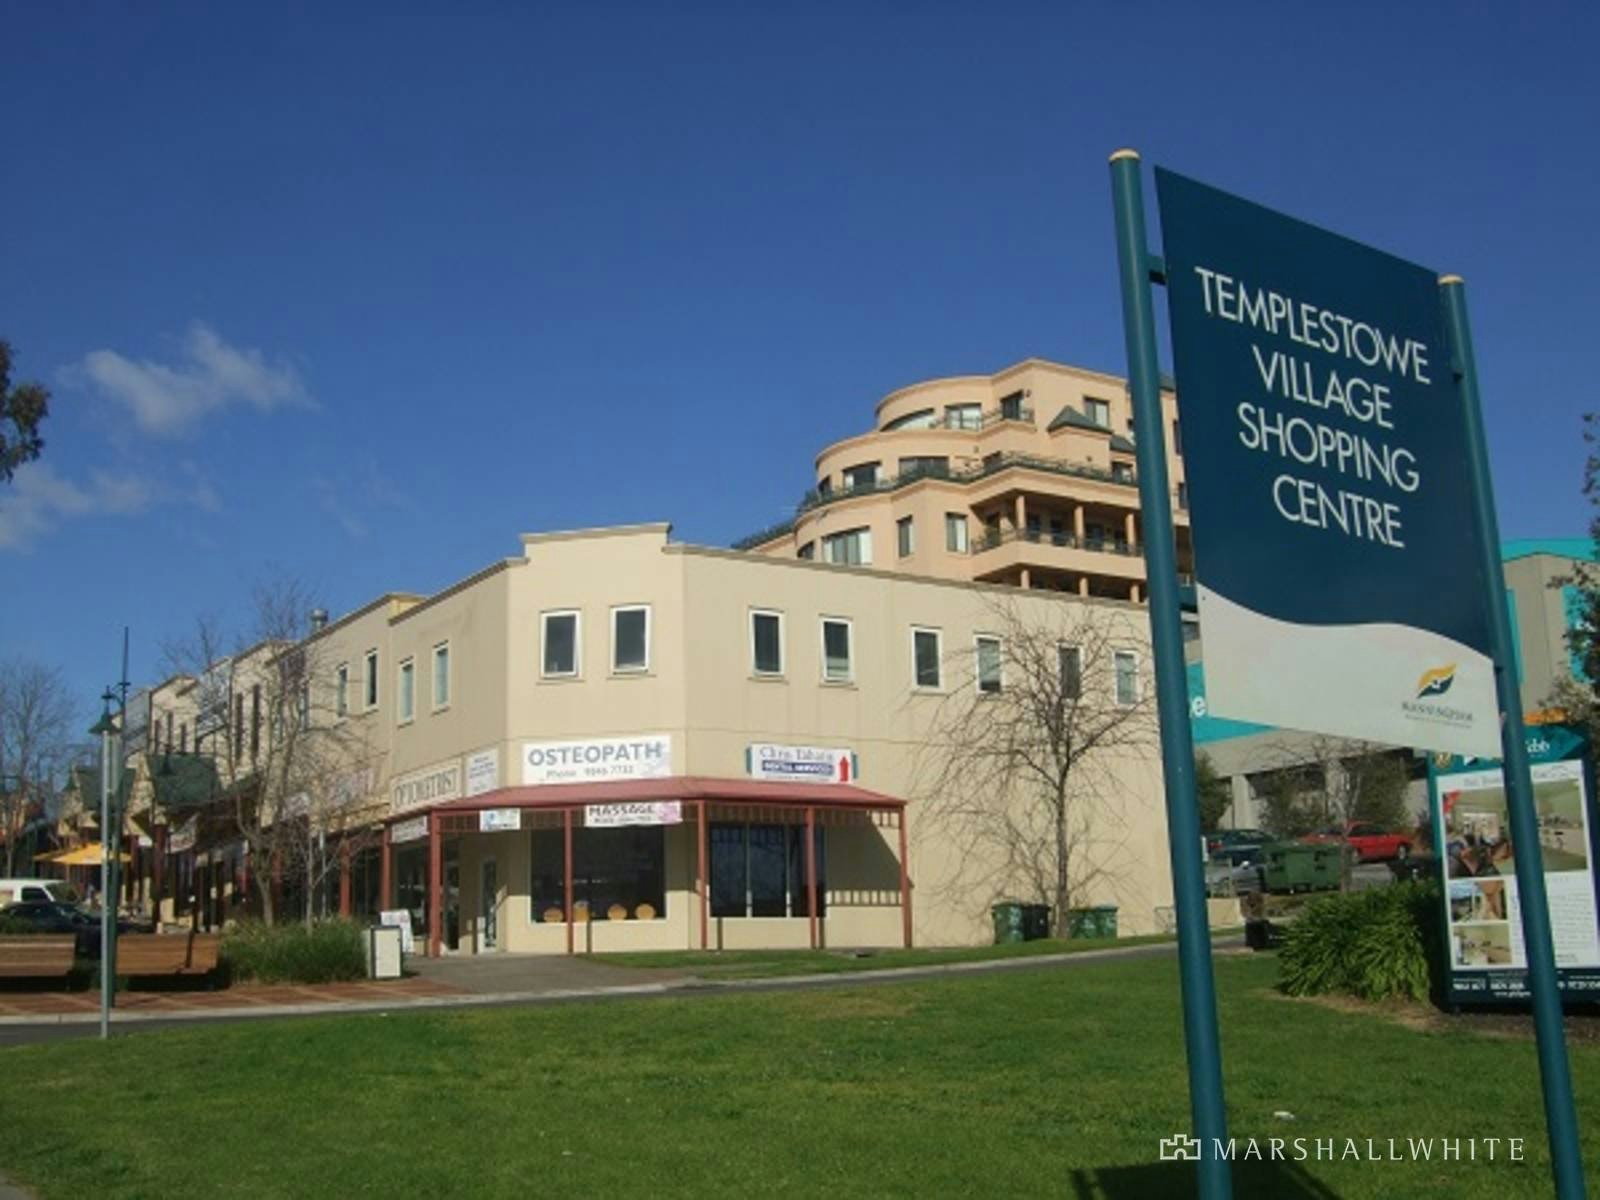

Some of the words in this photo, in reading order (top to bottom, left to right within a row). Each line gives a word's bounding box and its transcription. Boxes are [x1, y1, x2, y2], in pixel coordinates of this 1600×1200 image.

[1194, 265, 1431, 385] TEMPLESTOWE
[1252, 344, 1394, 430] VILLAGE
[1237, 401, 1421, 493] SHOPPING
[1272, 474, 1405, 548] CENTRE
[527, 740, 663, 767] OSTEOPATH
